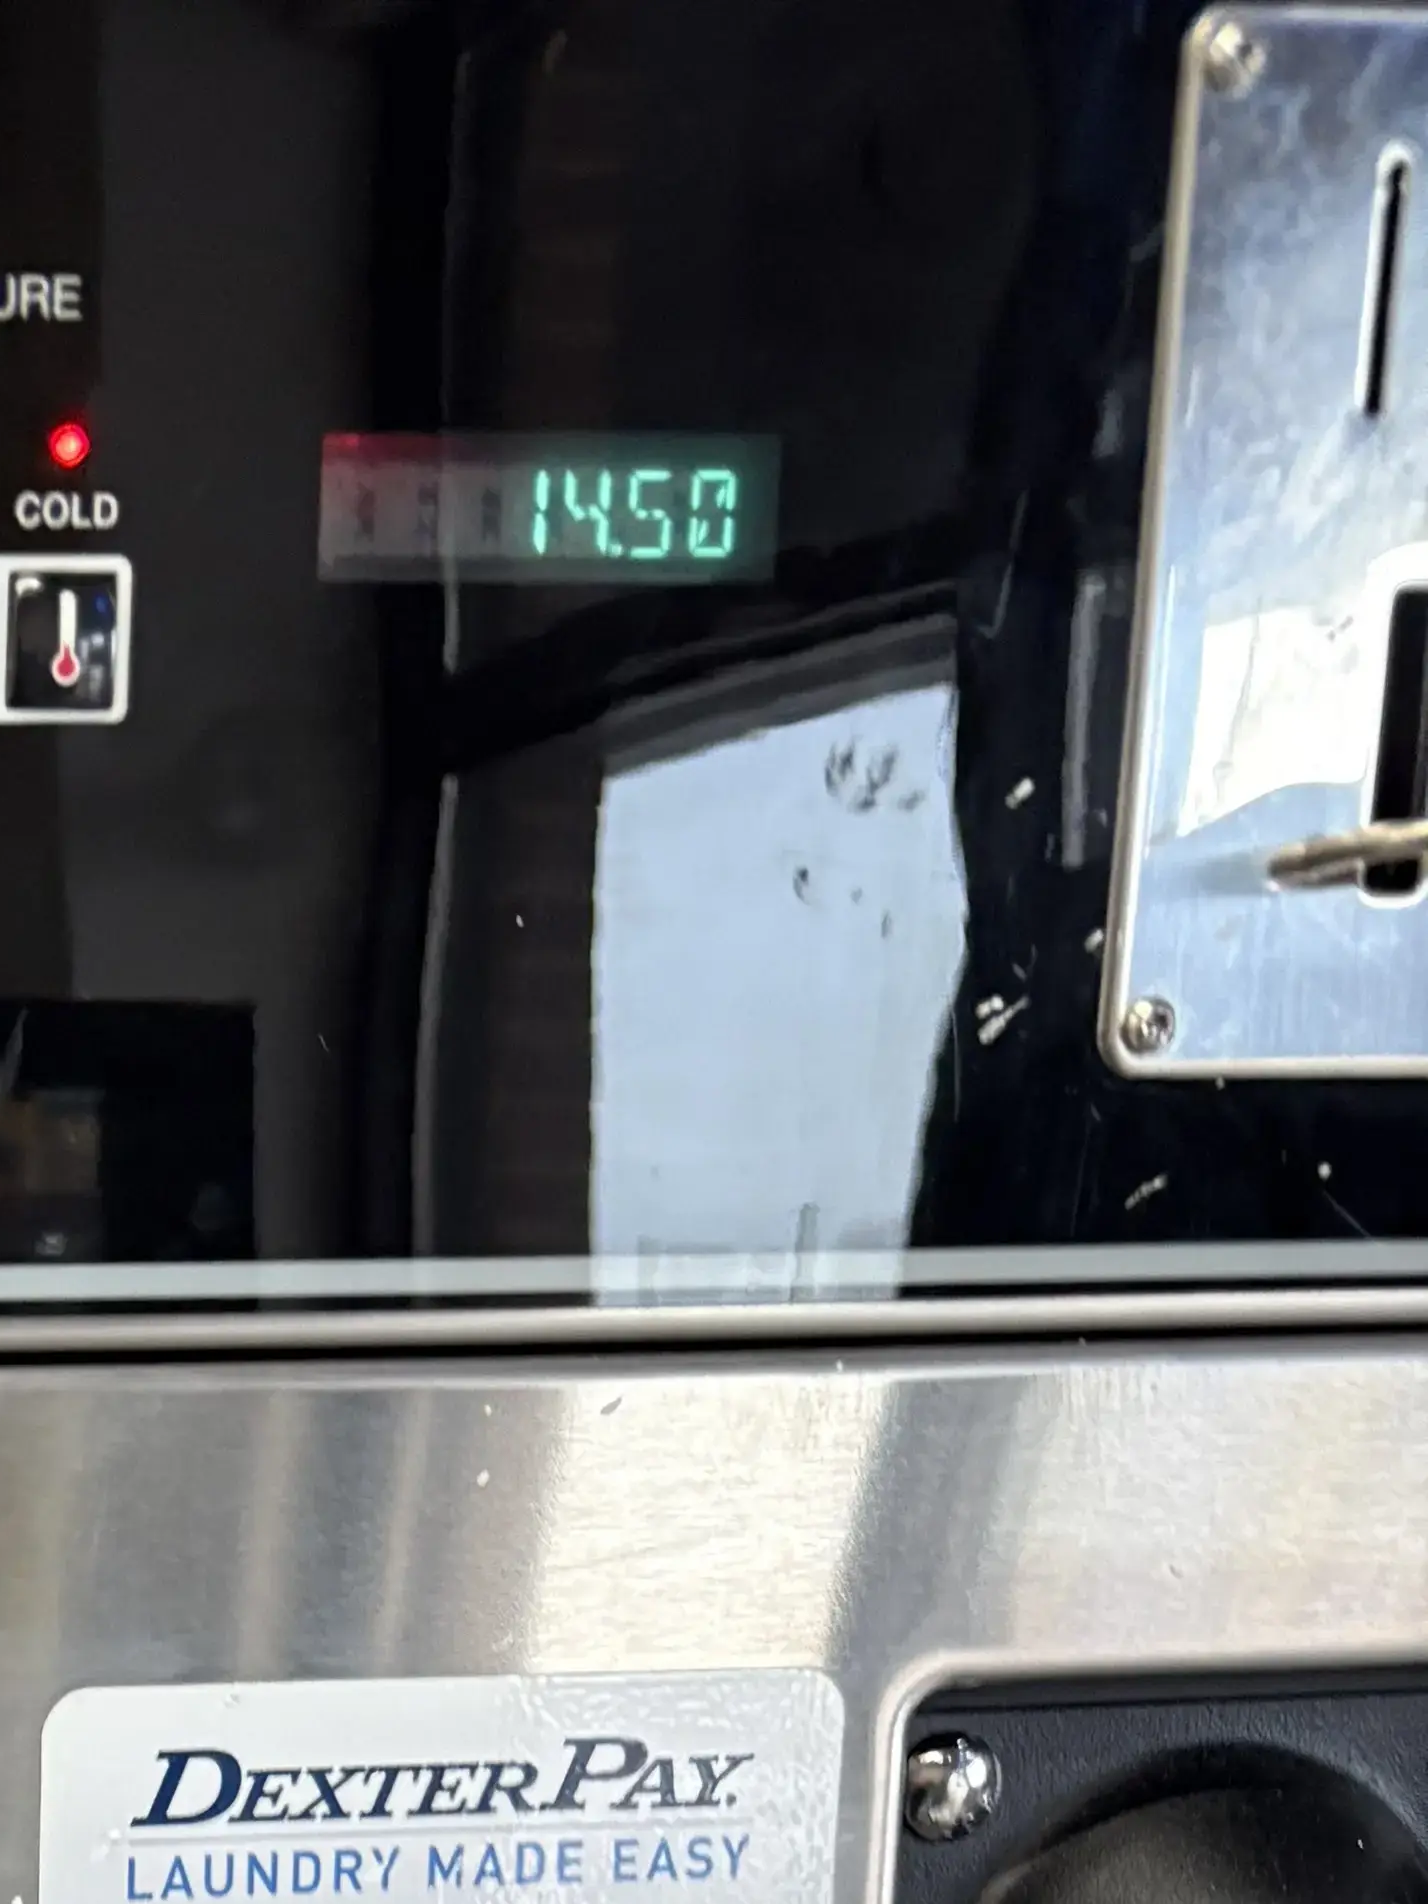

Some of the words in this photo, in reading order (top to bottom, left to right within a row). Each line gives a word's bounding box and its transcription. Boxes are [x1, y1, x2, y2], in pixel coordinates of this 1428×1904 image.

[15, 492, 118, 529] COLD
[127, 1846, 400, 1900] LAUNDRY
[428, 1840, 584, 1888] MADE
[612, 1835, 750, 1883] EASY
